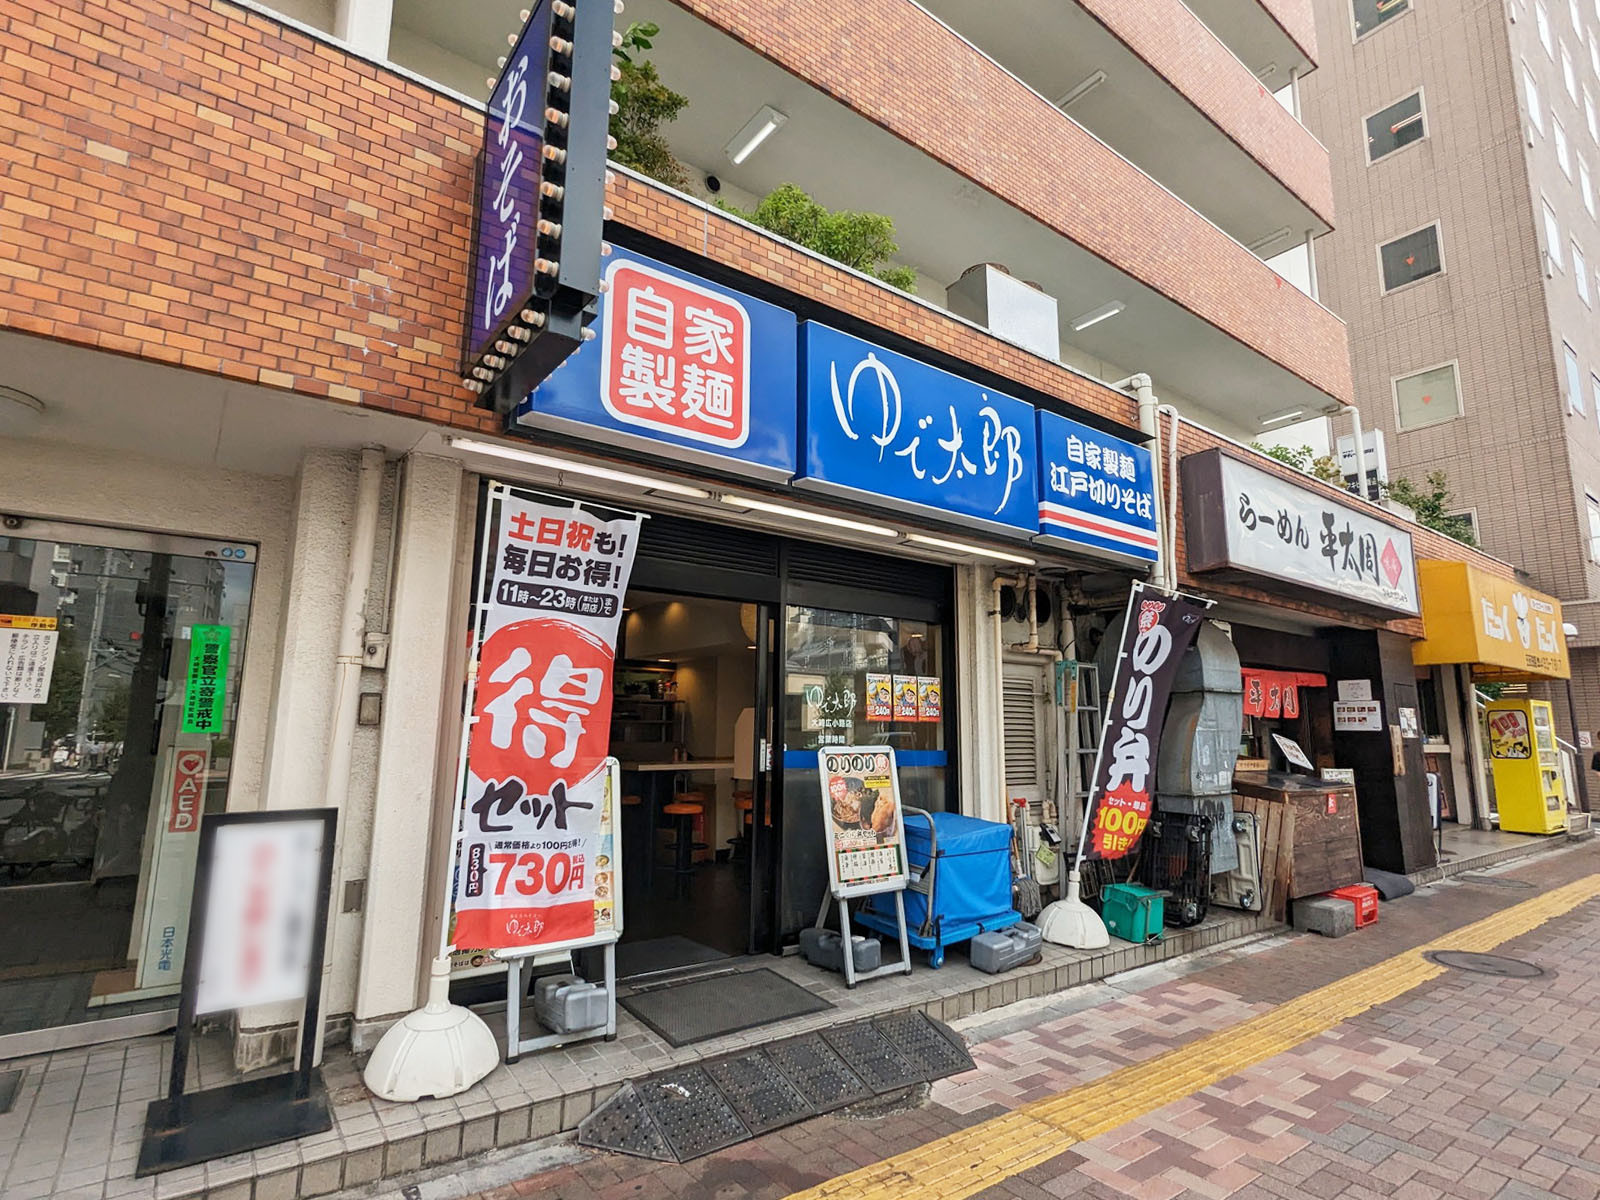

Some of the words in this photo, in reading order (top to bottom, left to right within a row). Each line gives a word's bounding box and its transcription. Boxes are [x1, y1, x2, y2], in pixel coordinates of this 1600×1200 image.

[485, 55, 528, 329] おそば
[626, 286, 734, 364] 自家
[618, 342, 734, 429] 製麺
[830, 352, 1023, 515] ゆで太郎
[1066, 434, 1136, 483] 自家製麺
[1050, 462, 1153, 520] 江戸切りそば
[1239, 493, 1310, 549] らーめん
[196, 644, 219, 730] 警察官立寄警戒中
[483, 647, 604, 769] 得
[1106, 624, 1172, 792] のり弁
[175, 777, 198, 829] AED
[471, 778, 594, 833] セット
[1099, 806, 1148, 836] 100円
[158, 926, 175, 972] 日本光電
